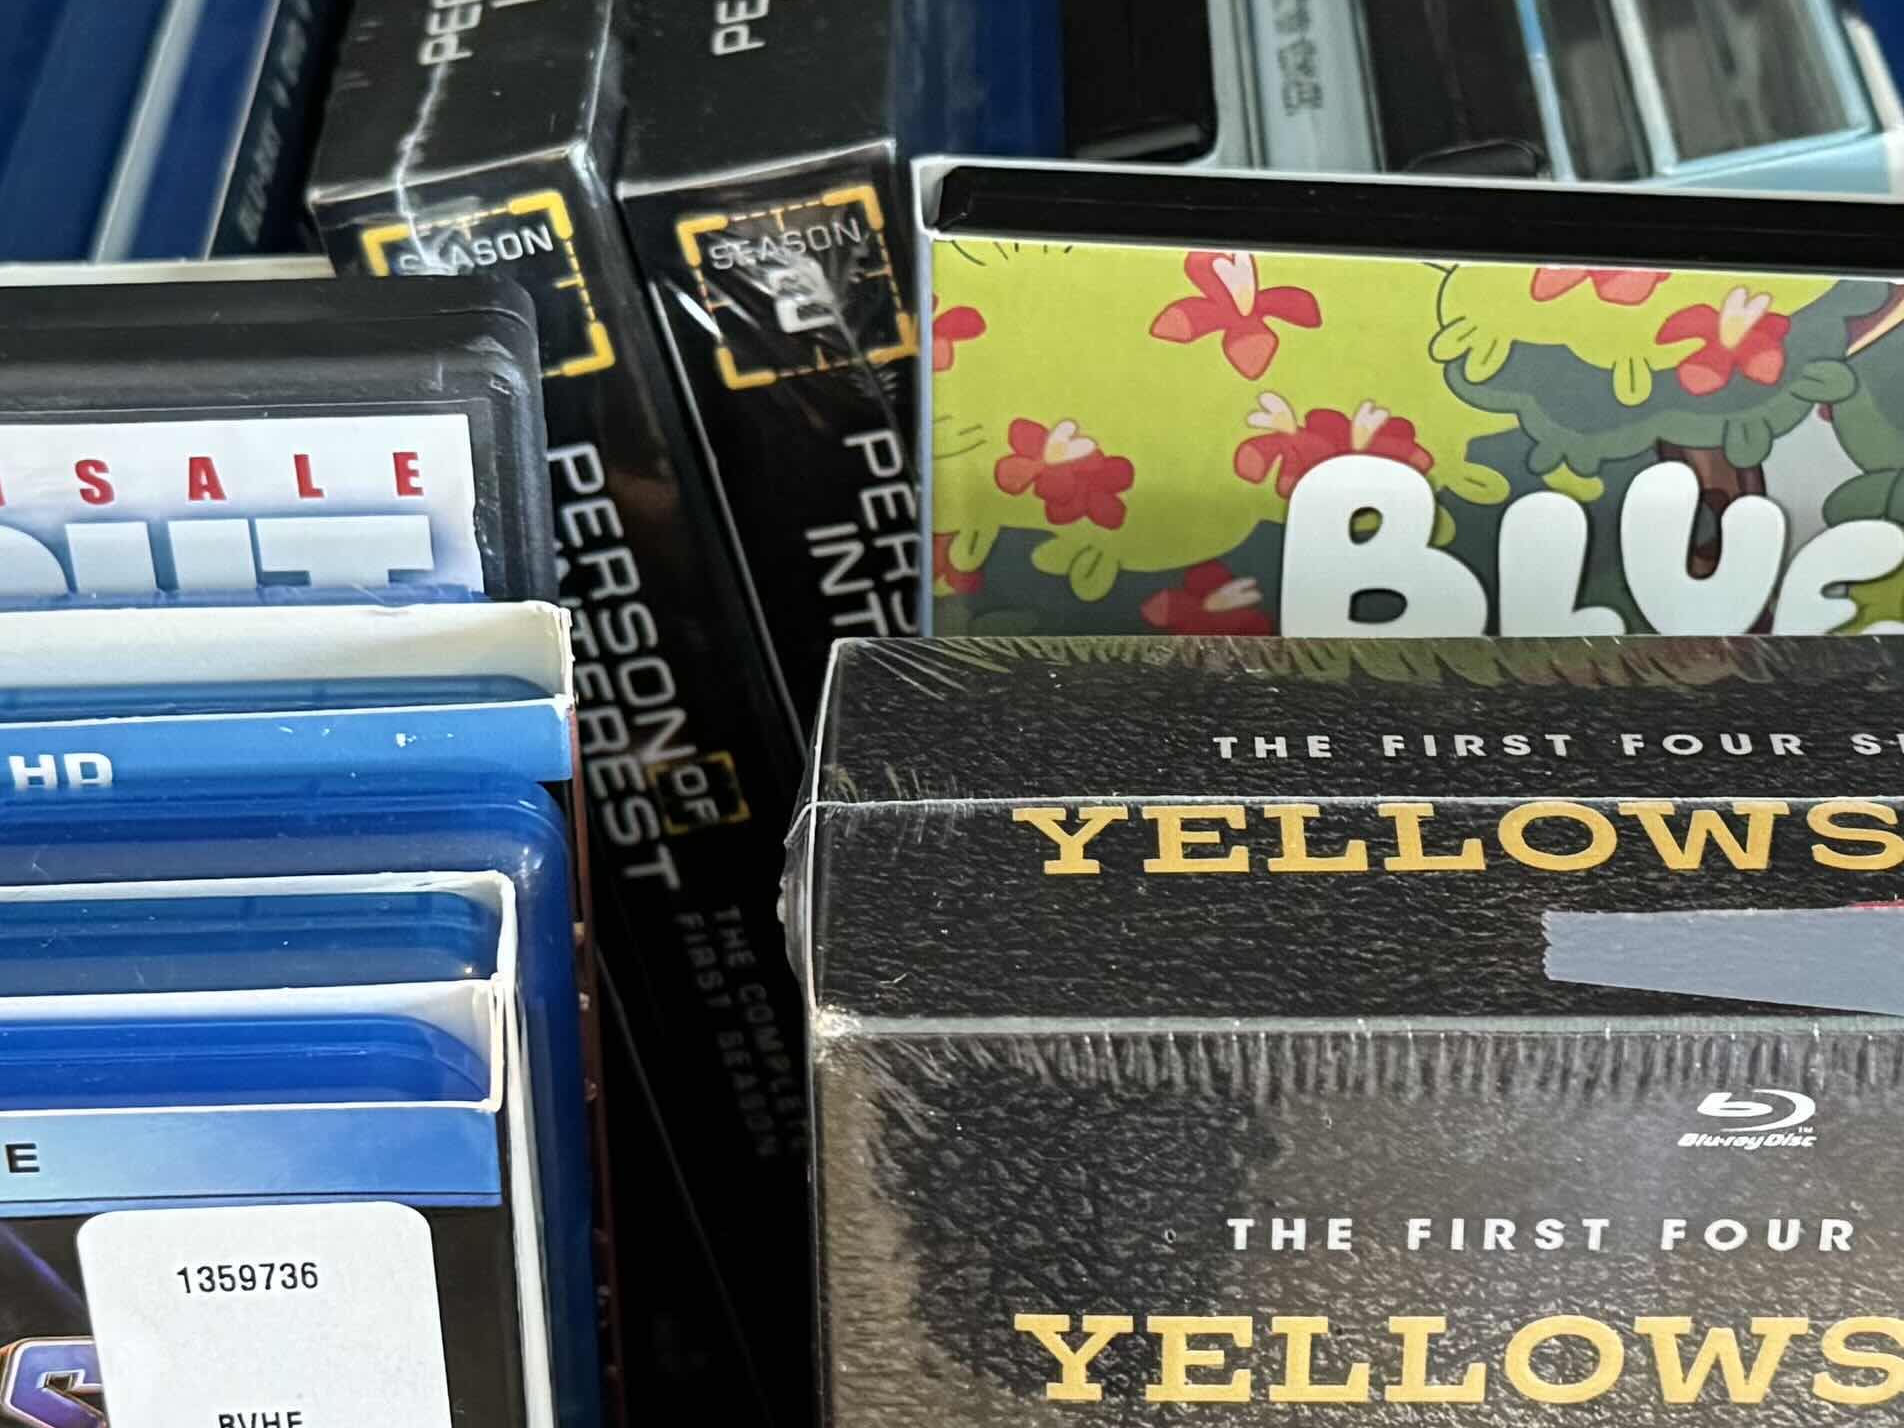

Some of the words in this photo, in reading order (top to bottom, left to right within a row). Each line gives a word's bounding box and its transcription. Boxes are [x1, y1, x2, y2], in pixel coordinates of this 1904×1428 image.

[707, 217, 863, 271] SEASON
[546, 440, 700, 767] PERSON
[671, 764, 722, 825] OF
[1212, 735, 1333, 760] THE
[1382, 733, 1573, 759] FIRST
[1622, 732, 1806, 758] FOUR
[9, 752, 115, 790] HD
[1227, 1217, 1354, 1252] THE
[1406, 1217, 1612, 1251] FIRST
[1660, 1218, 1856, 1252] FOUR
[174, 1260, 322, 1296] 1359736
